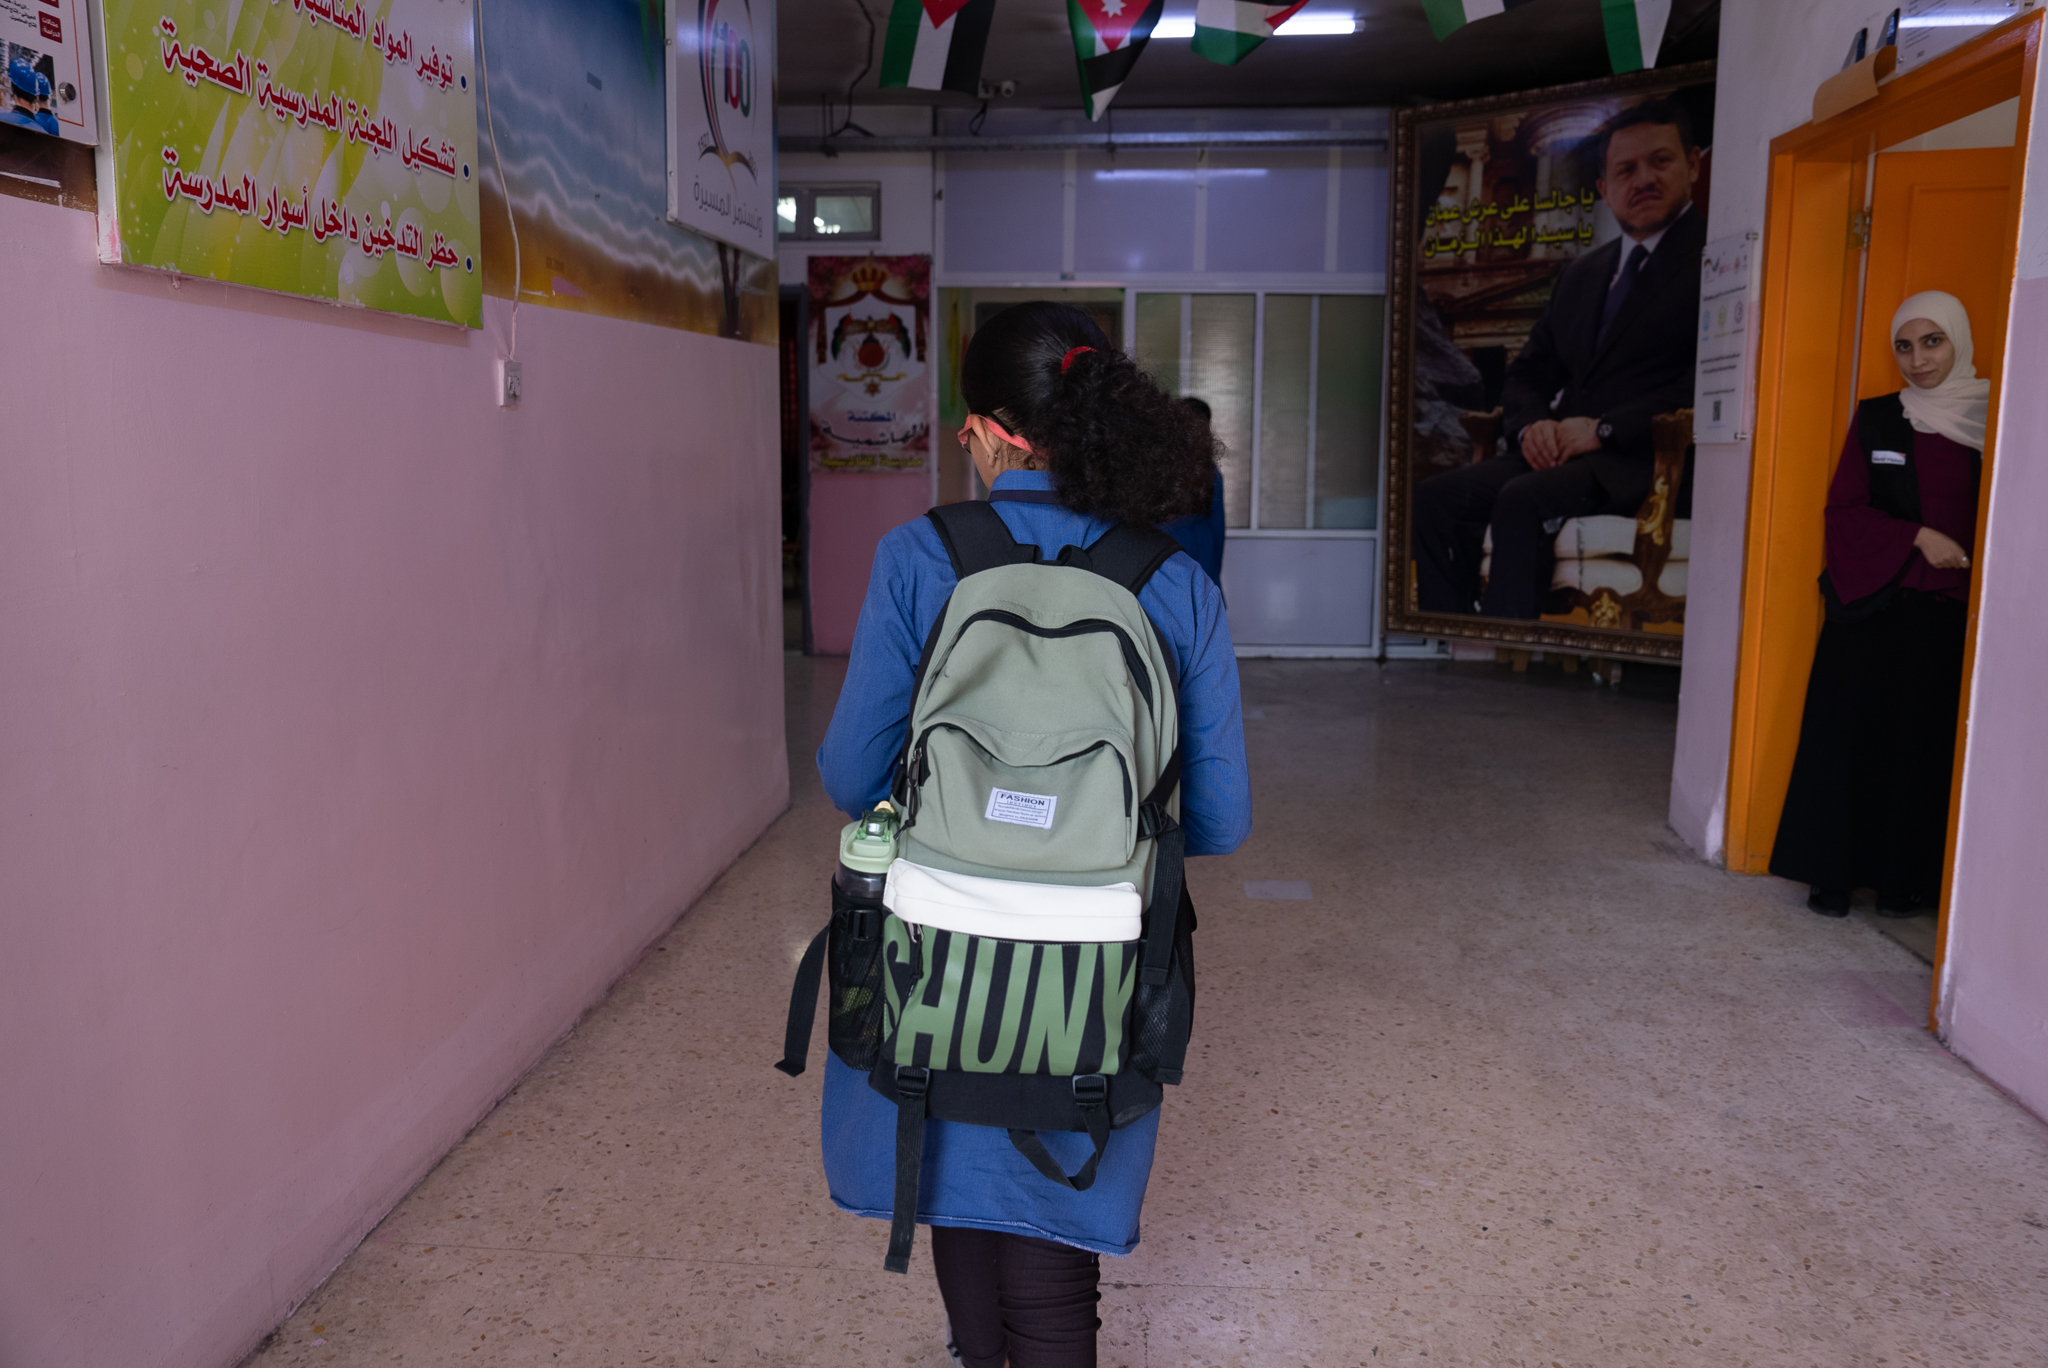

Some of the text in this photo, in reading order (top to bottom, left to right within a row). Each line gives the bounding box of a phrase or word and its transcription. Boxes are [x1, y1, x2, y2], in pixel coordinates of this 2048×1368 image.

[373, 19, 413, 63] المواد
[415, 45, 455, 89] توفير
[161, 19, 457, 177] تشكيل اللجنة المدرسية الصحية
[163, 148, 459, 270] حظر التدخين داخل أسوار المدرسة
[693, 174, 763, 238] وتستمر المسيرة
[1425, 187, 1595, 226] يا جالسا على عرش عمان
[1578, 217, 1593, 245] يا
[1000, 793, 1045, 806] FASHION
